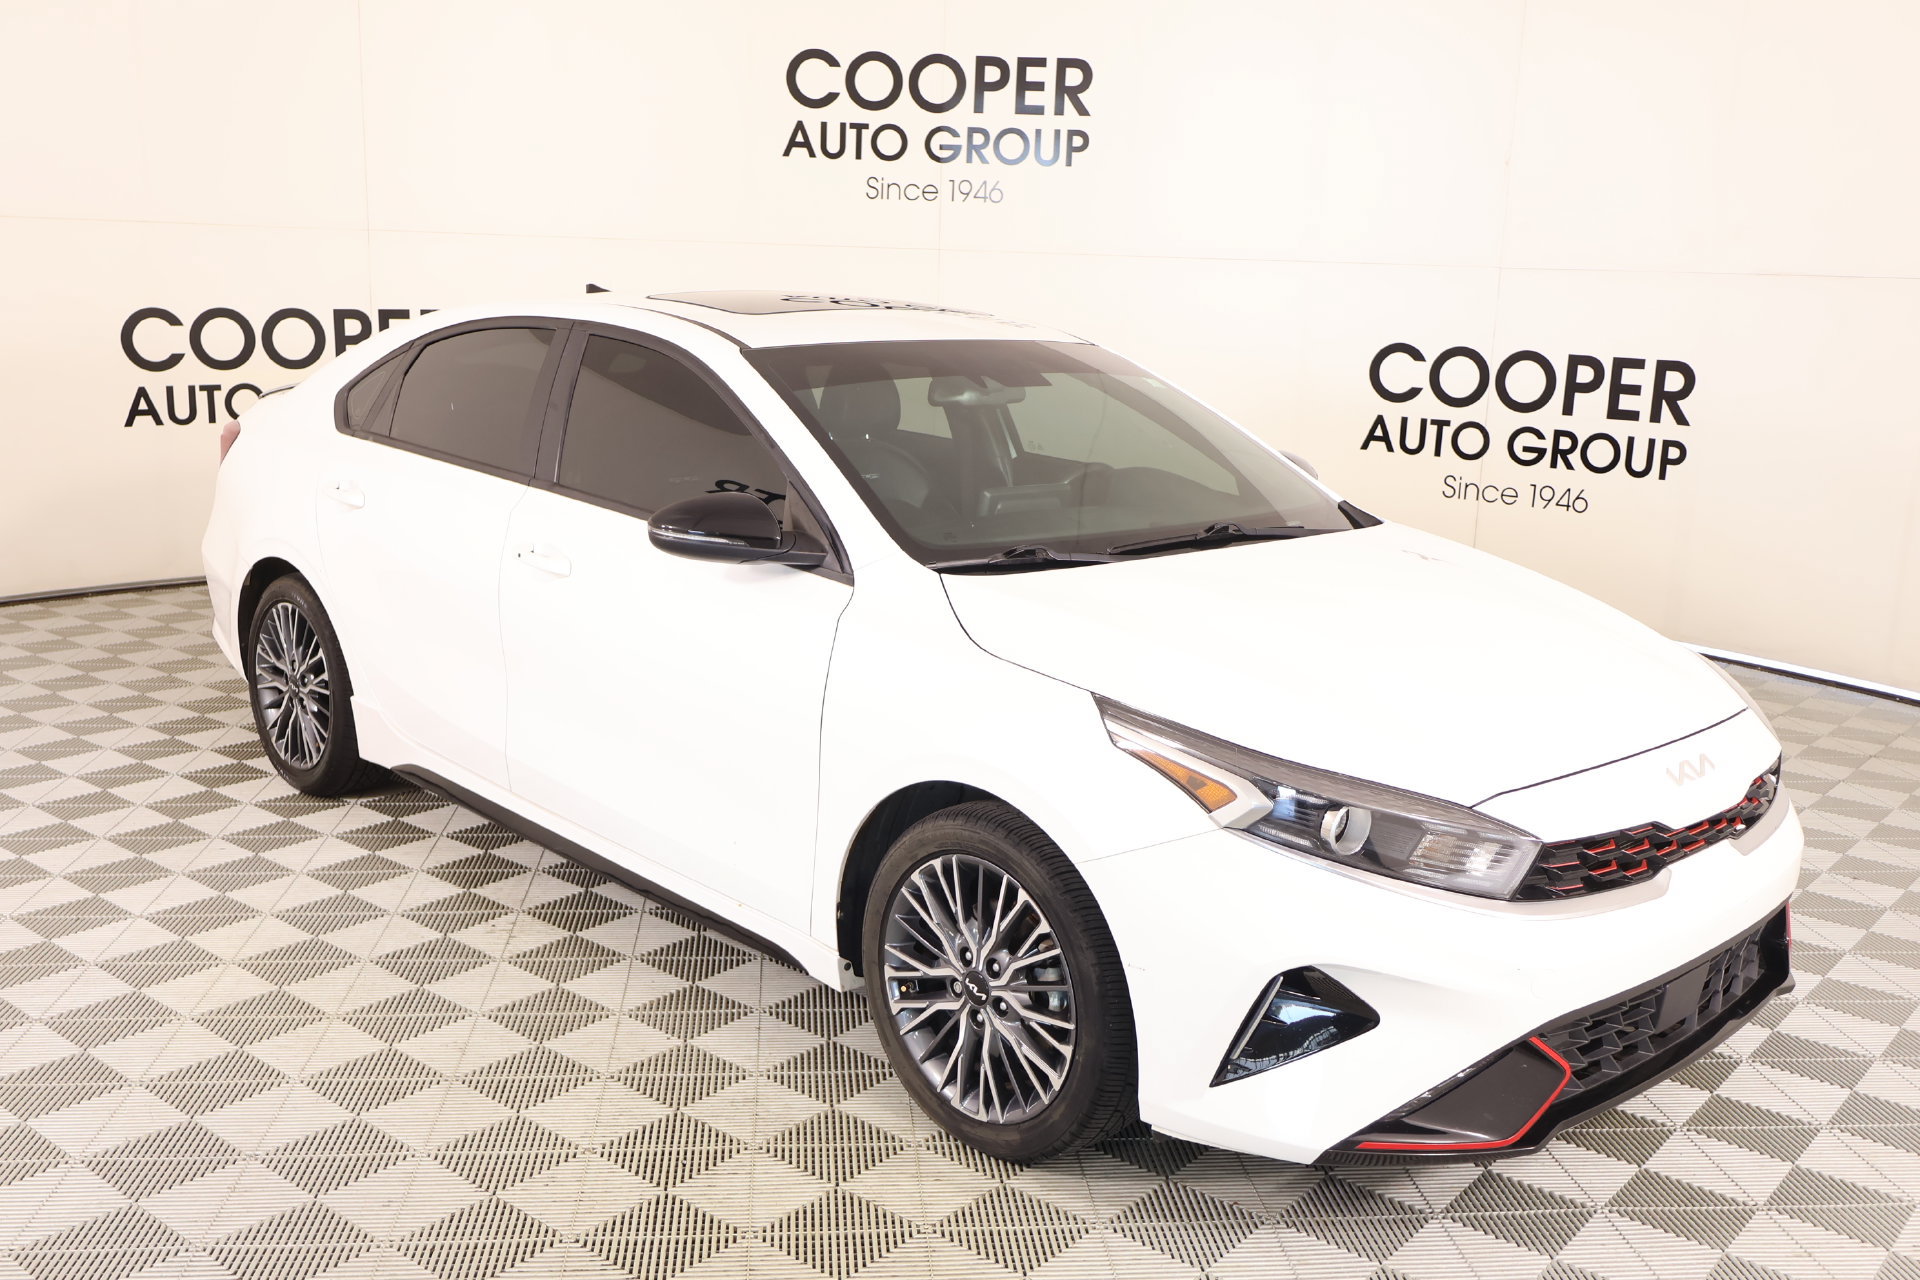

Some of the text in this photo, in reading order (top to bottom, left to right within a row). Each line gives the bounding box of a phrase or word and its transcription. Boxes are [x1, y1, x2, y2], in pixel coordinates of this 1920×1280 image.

[785, 48, 1094, 117] COOPER
[782, 120, 1090, 168] AUTO GROUP
[866, 176, 1004, 204] Since 1946
[120, 307, 440, 373] COOP
[1368, 342, 1697, 427] COOPER
[1360, 414, 1688, 481] AUTO GROUP
[1442, 474, 1589, 514] Since 1946
